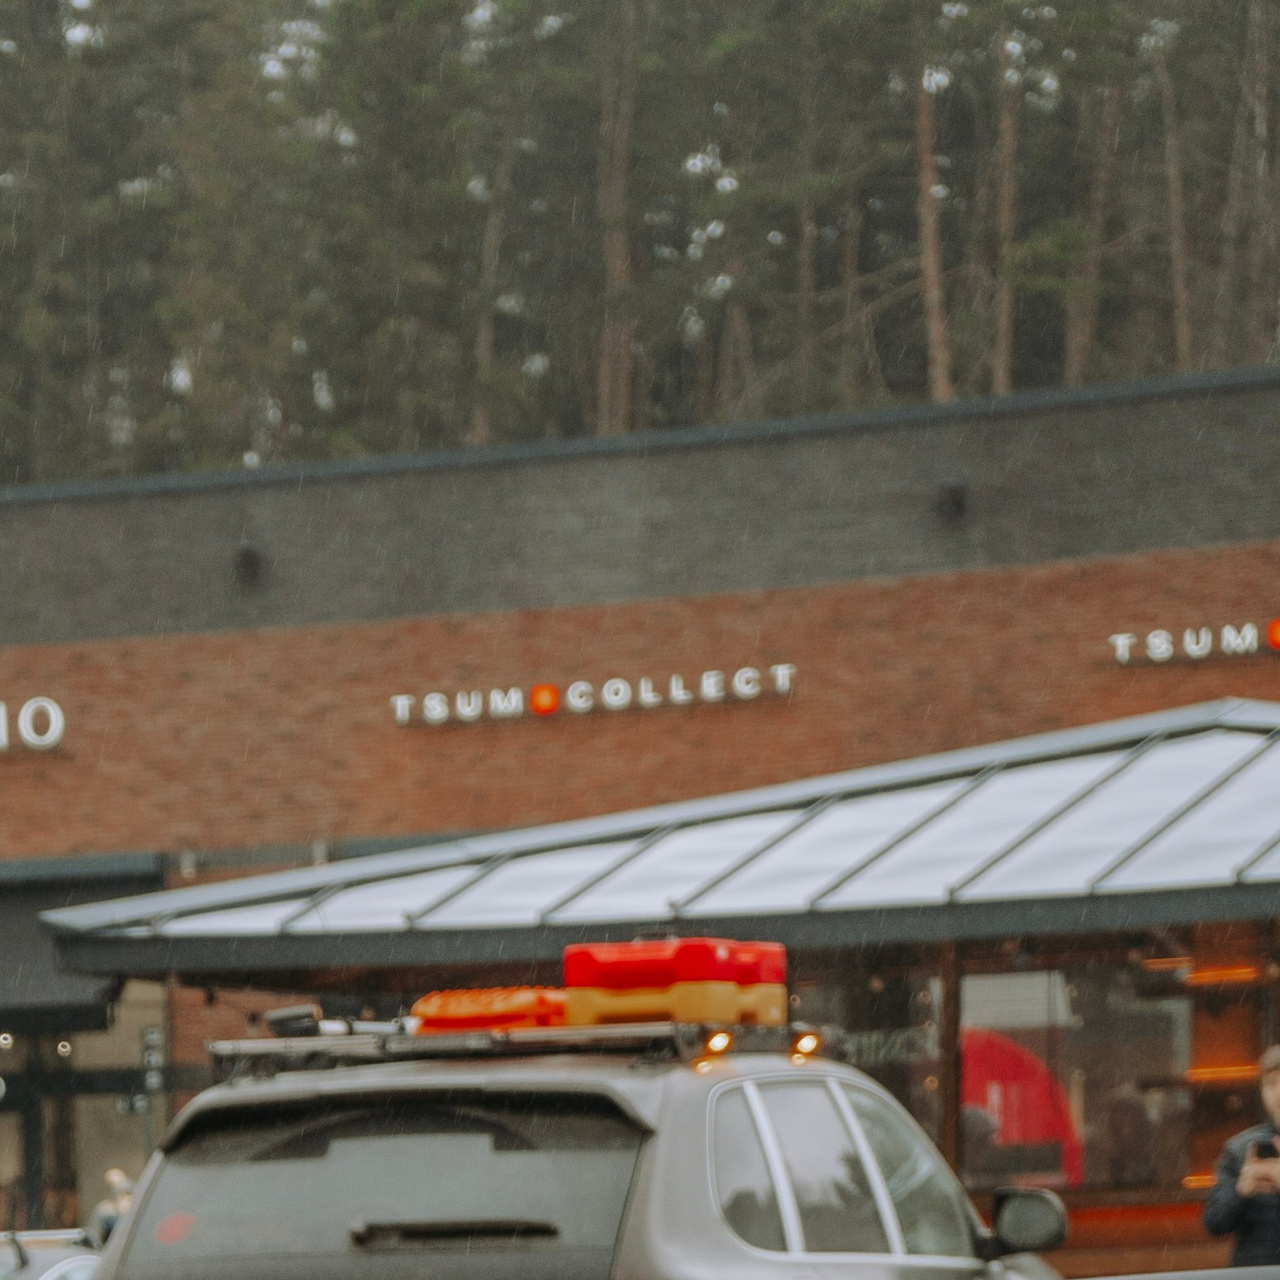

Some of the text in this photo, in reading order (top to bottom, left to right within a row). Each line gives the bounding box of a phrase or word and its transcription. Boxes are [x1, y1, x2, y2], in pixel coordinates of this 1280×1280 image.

[1109, 623, 1259, 664] TSUM
[391, 664, 796, 724] TSUM COLLECT
